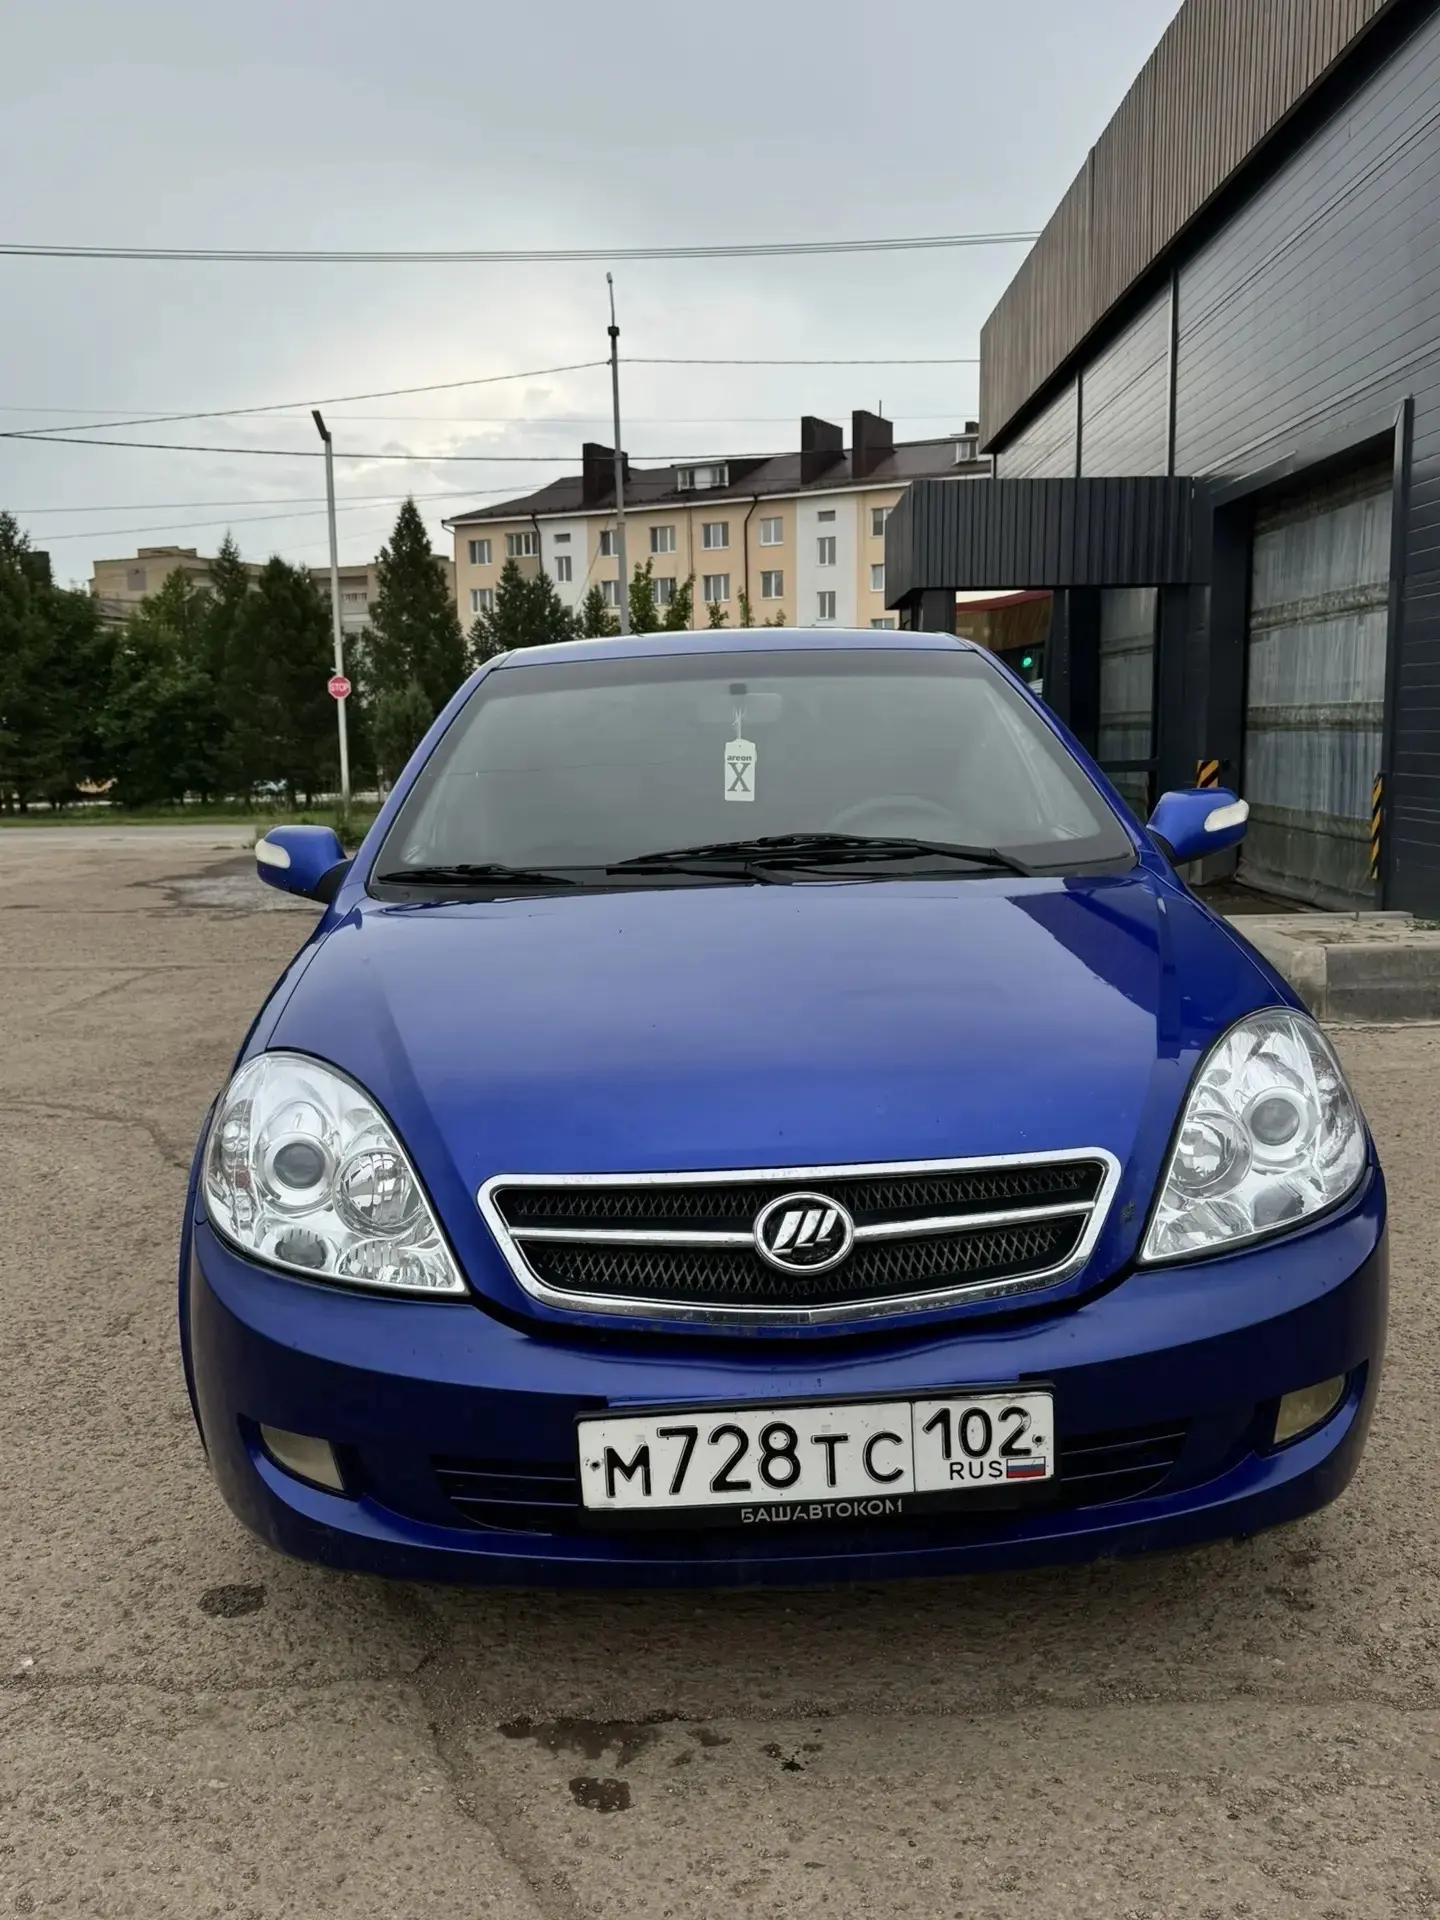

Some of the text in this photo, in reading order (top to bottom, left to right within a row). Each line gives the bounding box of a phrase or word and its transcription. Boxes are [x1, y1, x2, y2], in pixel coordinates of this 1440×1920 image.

[331, 683, 349, 692] STOP
[727, 762, 751, 792] X
[922, 1405, 1031, 1460] 102
[949, 1461, 1003, 1480] RUS
[741, 1499, 902, 1523] БАШАВТОКОМ
